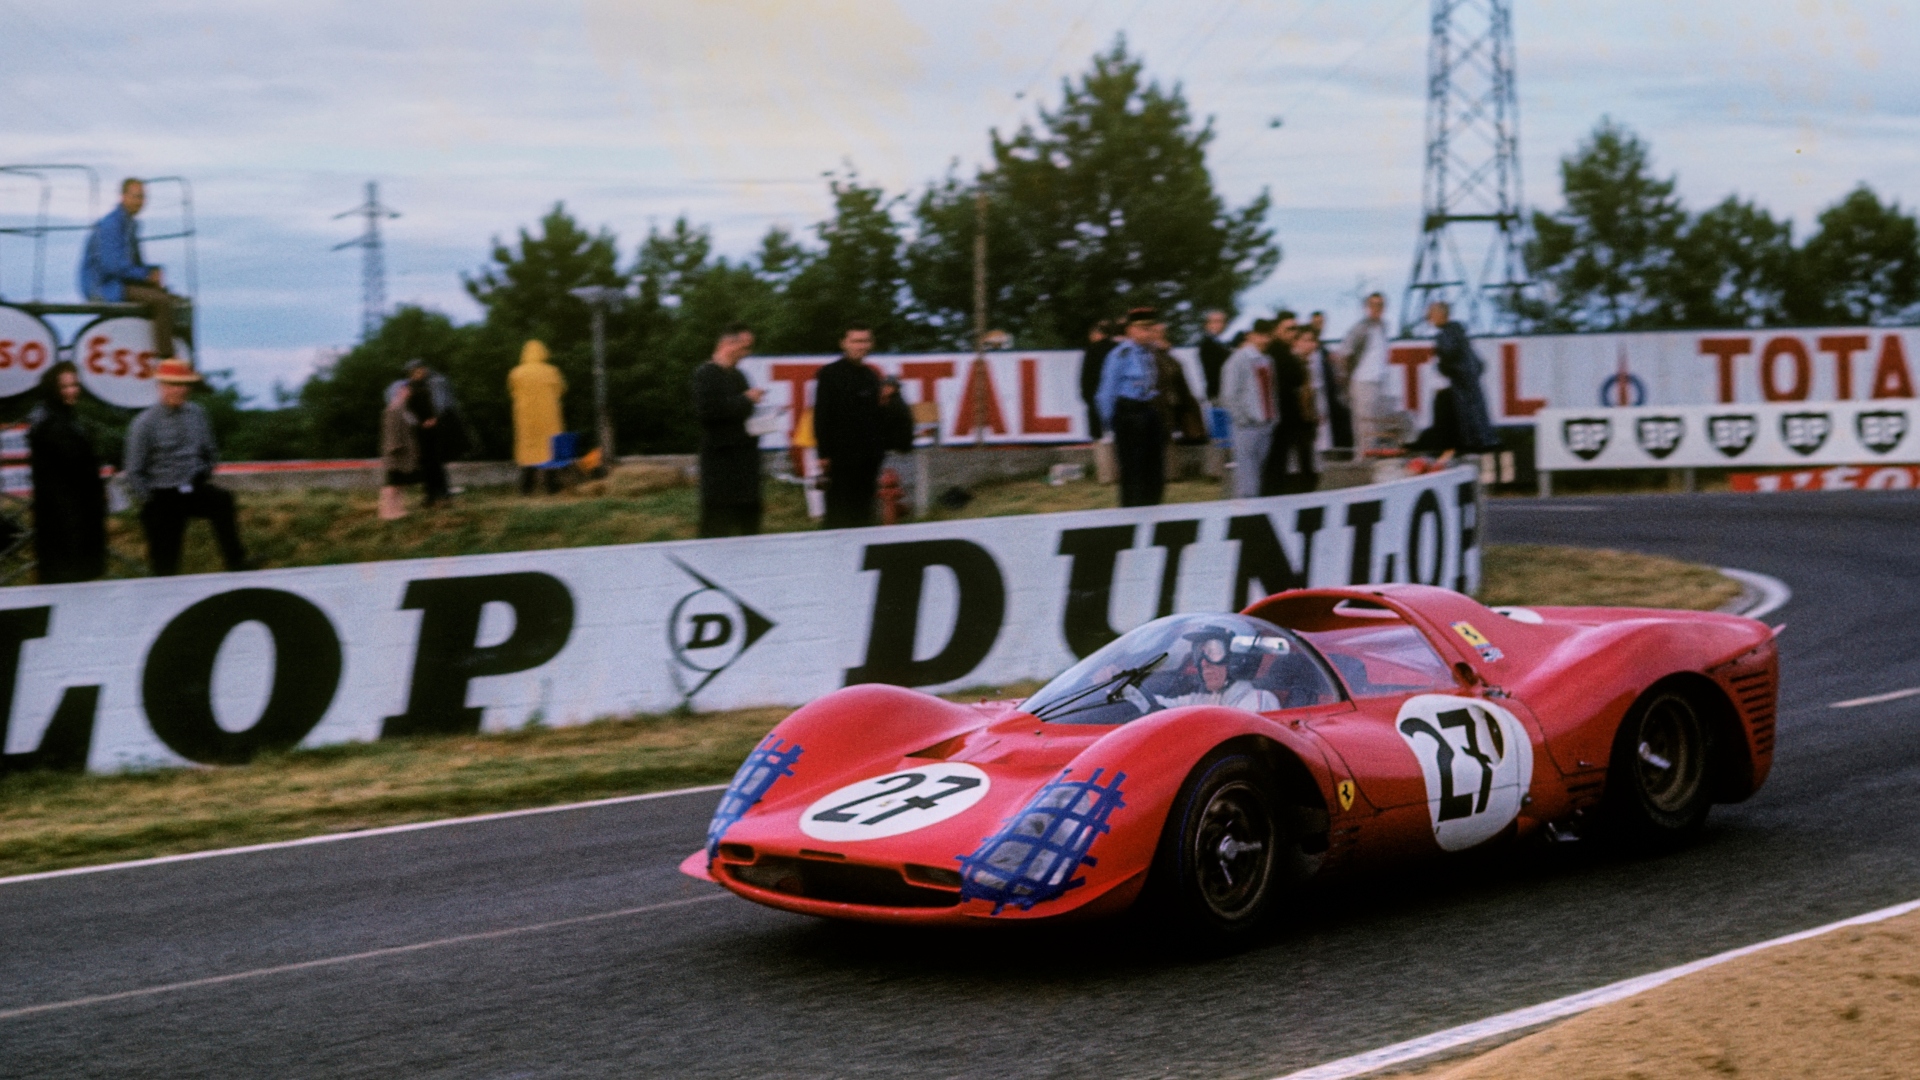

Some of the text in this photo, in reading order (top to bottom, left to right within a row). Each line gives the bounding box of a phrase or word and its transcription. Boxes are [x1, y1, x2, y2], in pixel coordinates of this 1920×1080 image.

[86, 334, 156, 380] Ess
[771, 359, 1071, 437] TTAL
[1567, 417, 1903, 450] BP BP BP BP BP
[686, 613, 733, 649] D
[844, 481, 1477, 690] DUNLOP
[1400, 708, 1493, 822] 27
[812, 773, 982, 826] 27
